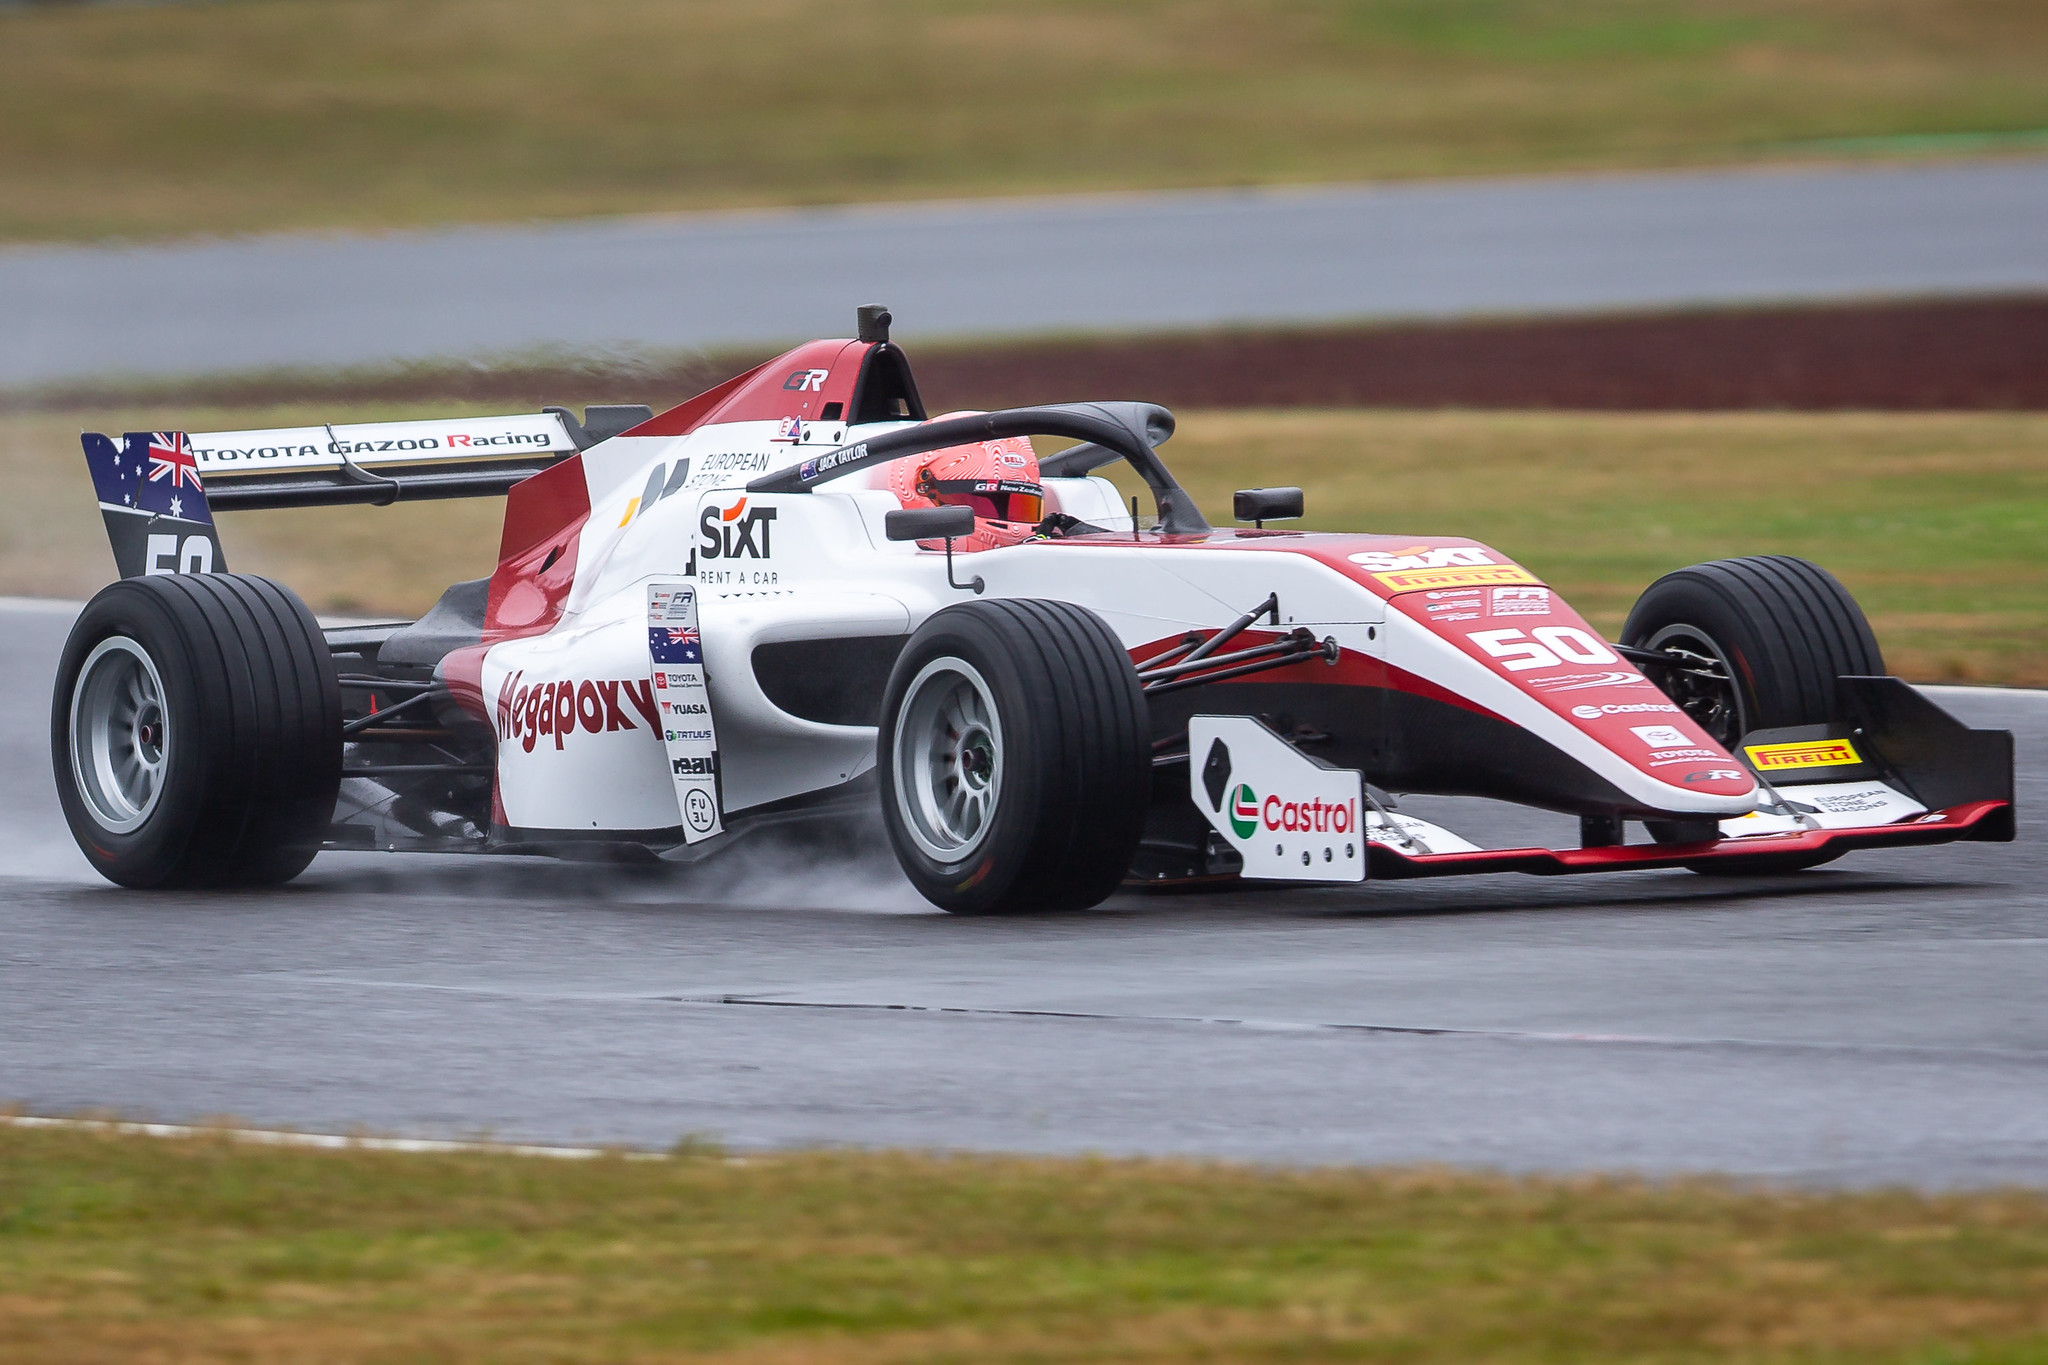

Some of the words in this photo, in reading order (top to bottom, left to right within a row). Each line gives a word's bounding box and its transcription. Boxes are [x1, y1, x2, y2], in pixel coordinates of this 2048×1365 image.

[780, 420, 789, 433] E
[193, 443, 319, 462] TOYOTA
[328, 436, 440, 455] GAZOO
[446, 430, 552, 449] Racing
[701, 453, 771, 472] EUROPEAN
[818, 455, 838, 472] JACK
[838, 443, 868, 466] TAYLOR
[1004, 456, 1024, 464] BELL
[700, 571, 732, 584] RENT
[738, 571, 746, 584] A
[753, 571, 778, 585] CAR
[1388, 568, 1523, 587] PIRELLI
[1466, 626, 1619, 671] 50
[667, 673, 698, 683] TOYOTA
[496, 669, 664, 754] Megapoxy
[672, 703, 708, 715] YUASA
[1601, 703, 1682, 715] Castrol
[1649, 749, 1718, 760] TOYOTA
[1757, 745, 1851, 766] PIRELLI
[690, 798, 706, 810] FU
[1263, 794, 1355, 834] Castrol
